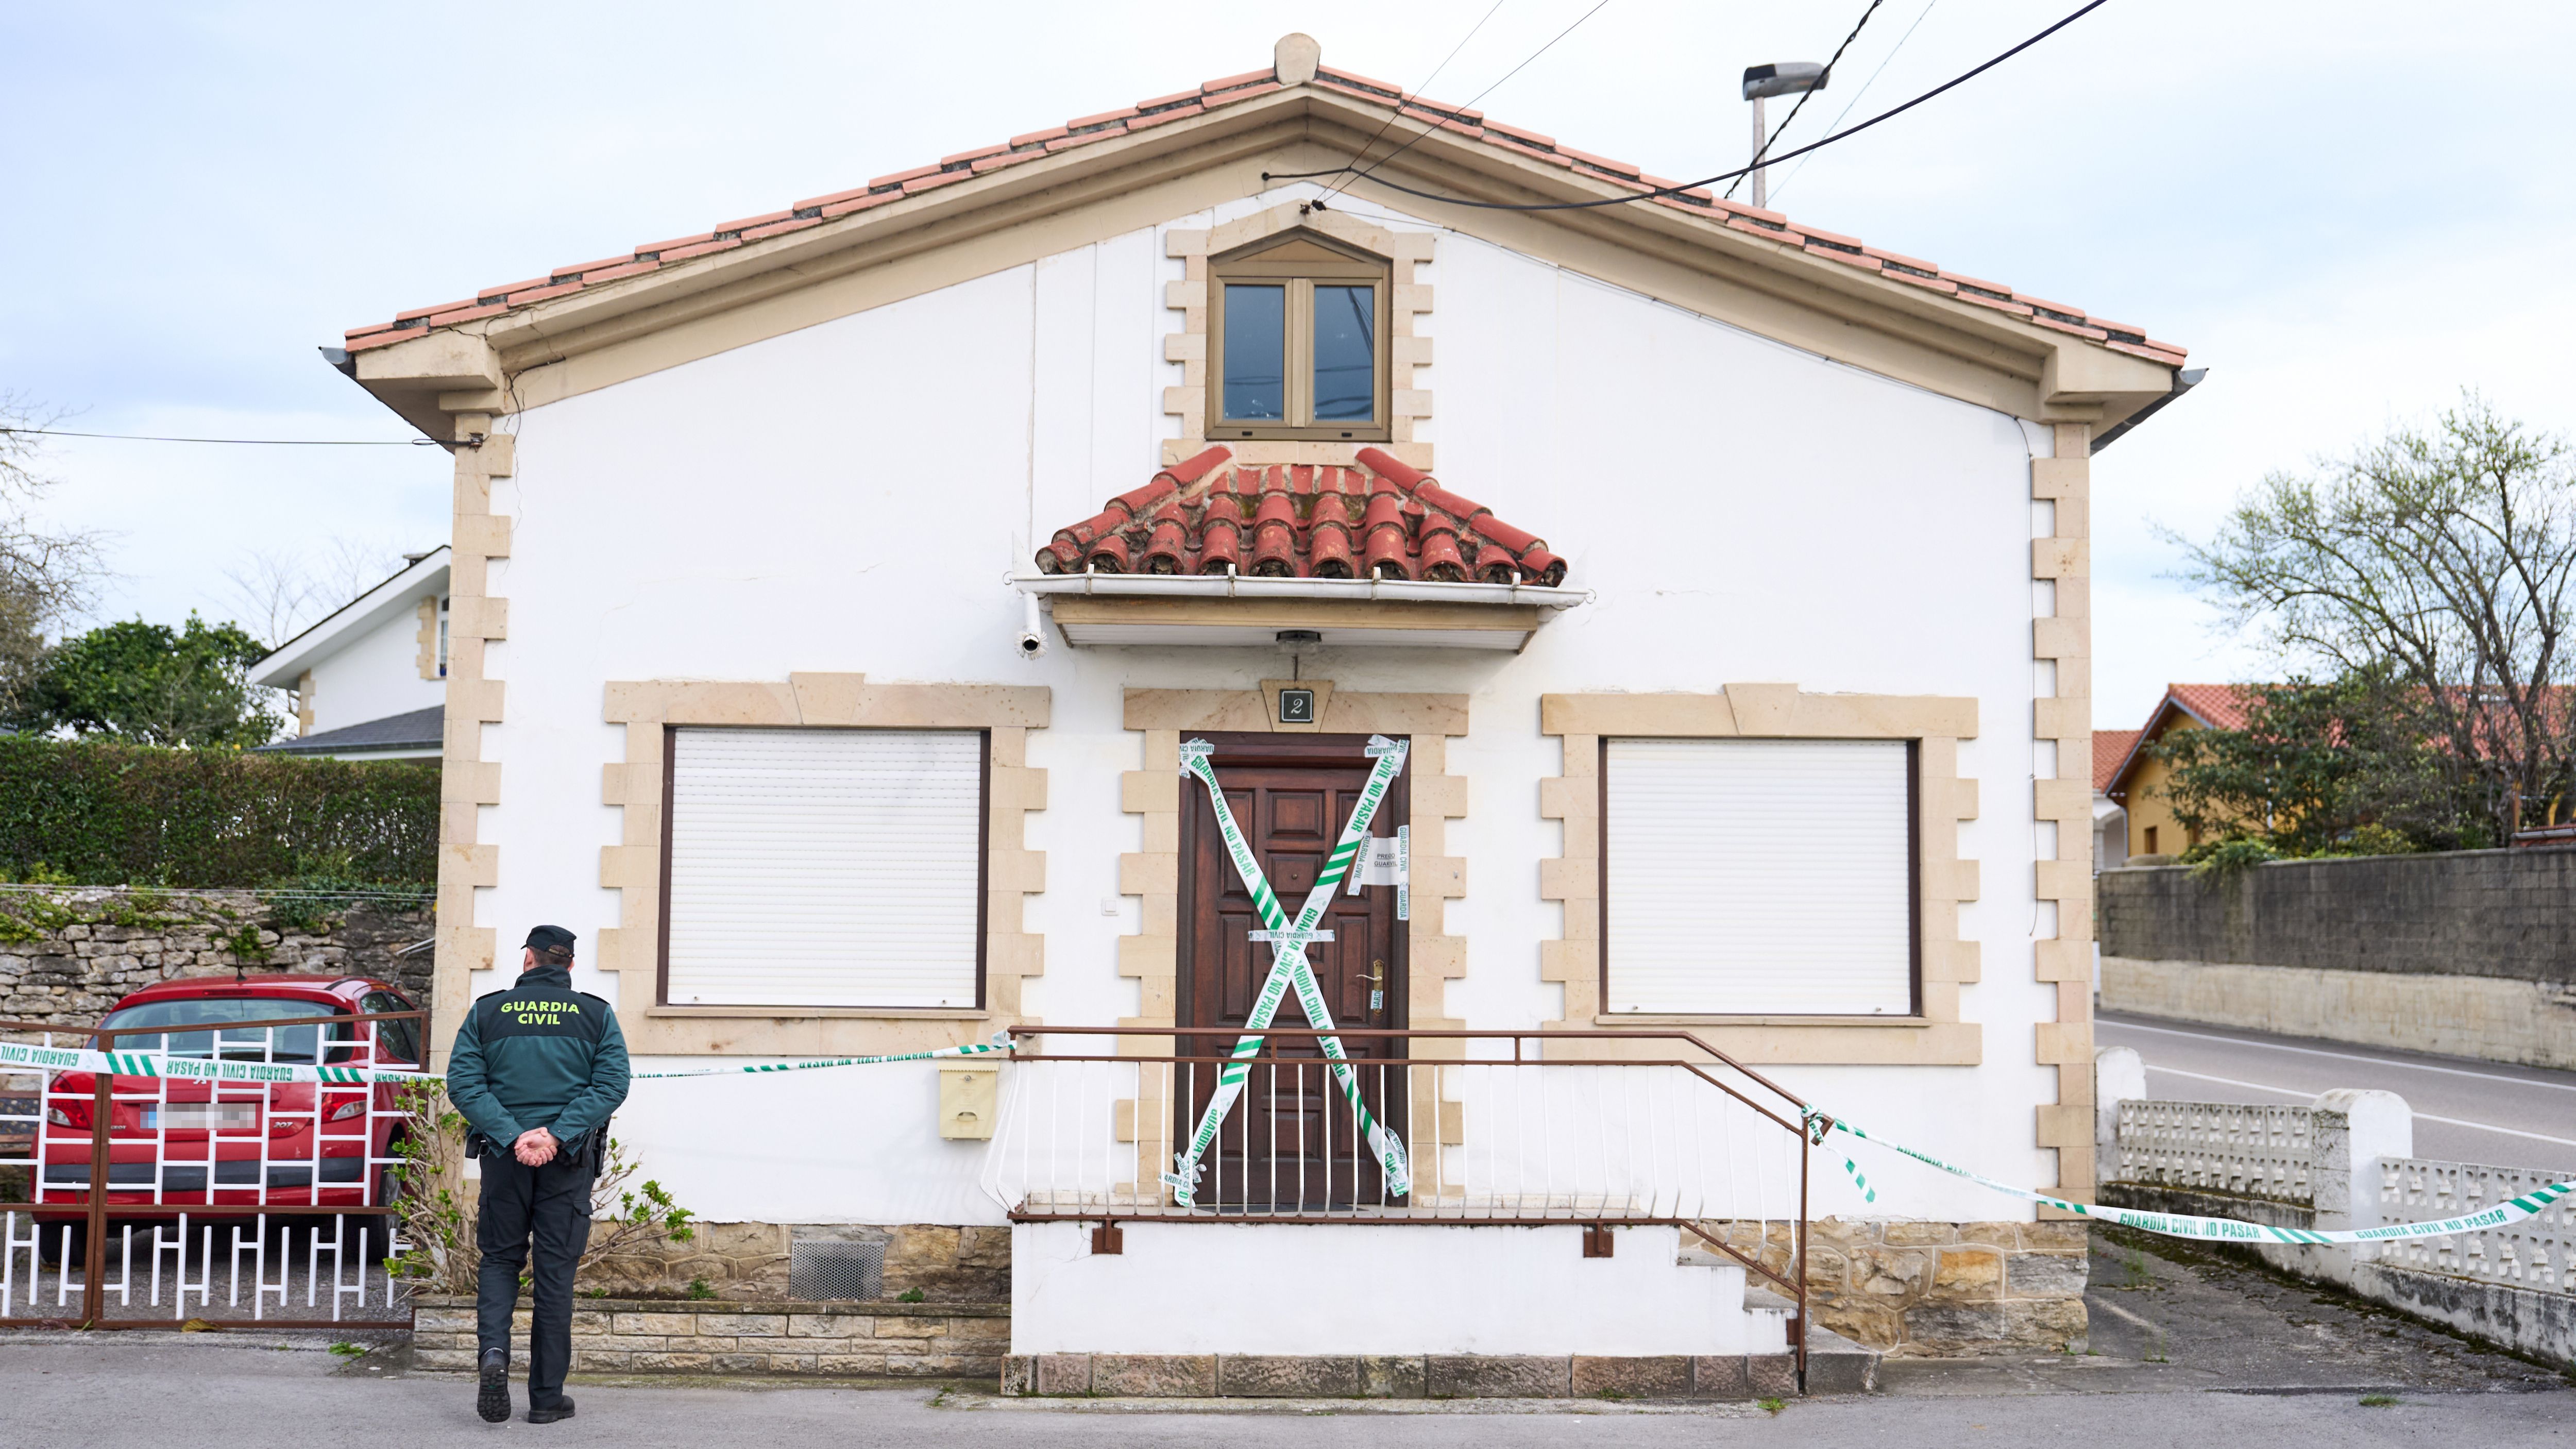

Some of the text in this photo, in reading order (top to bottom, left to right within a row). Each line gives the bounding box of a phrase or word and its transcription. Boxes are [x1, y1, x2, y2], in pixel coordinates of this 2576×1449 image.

[1291, 698, 1303, 714] 2
[1367, 747, 1392, 755] UARDIA
[1368, 780, 1384, 797] NO
[1191, 755, 1219, 796] GUARDIA
[1215, 797, 1228, 824] CIVIL
[1225, 824, 1238, 842] NO
[1232, 841, 1256, 878] PASAR
[1351, 797, 1376, 833] PASAR
[1353, 835, 1370, 879] GUARDIA CIVIL
[1275, 951, 1296, 978] CIVIL
[1267, 979, 1284, 996] NO
[501, 1001, 580, 1014] GUARDIA
[1305, 997, 1325, 1025] CIVIL
[518, 1013, 561, 1025] CIVIL
[1, 1046, 79, 1066] GUARDIA CIVIL
[166, 1060, 293, 1081] GUARDIA CIVIL NO PASAR
[2119, 1212, 2167, 1233] GUARDIA
[2172, 1218, 2198, 1235] CIVIL
[2222, 1222, 2261, 1239] PASAR
[2355, 1209, 2507, 1239] GUARDIA CIVIL NO PASAR
